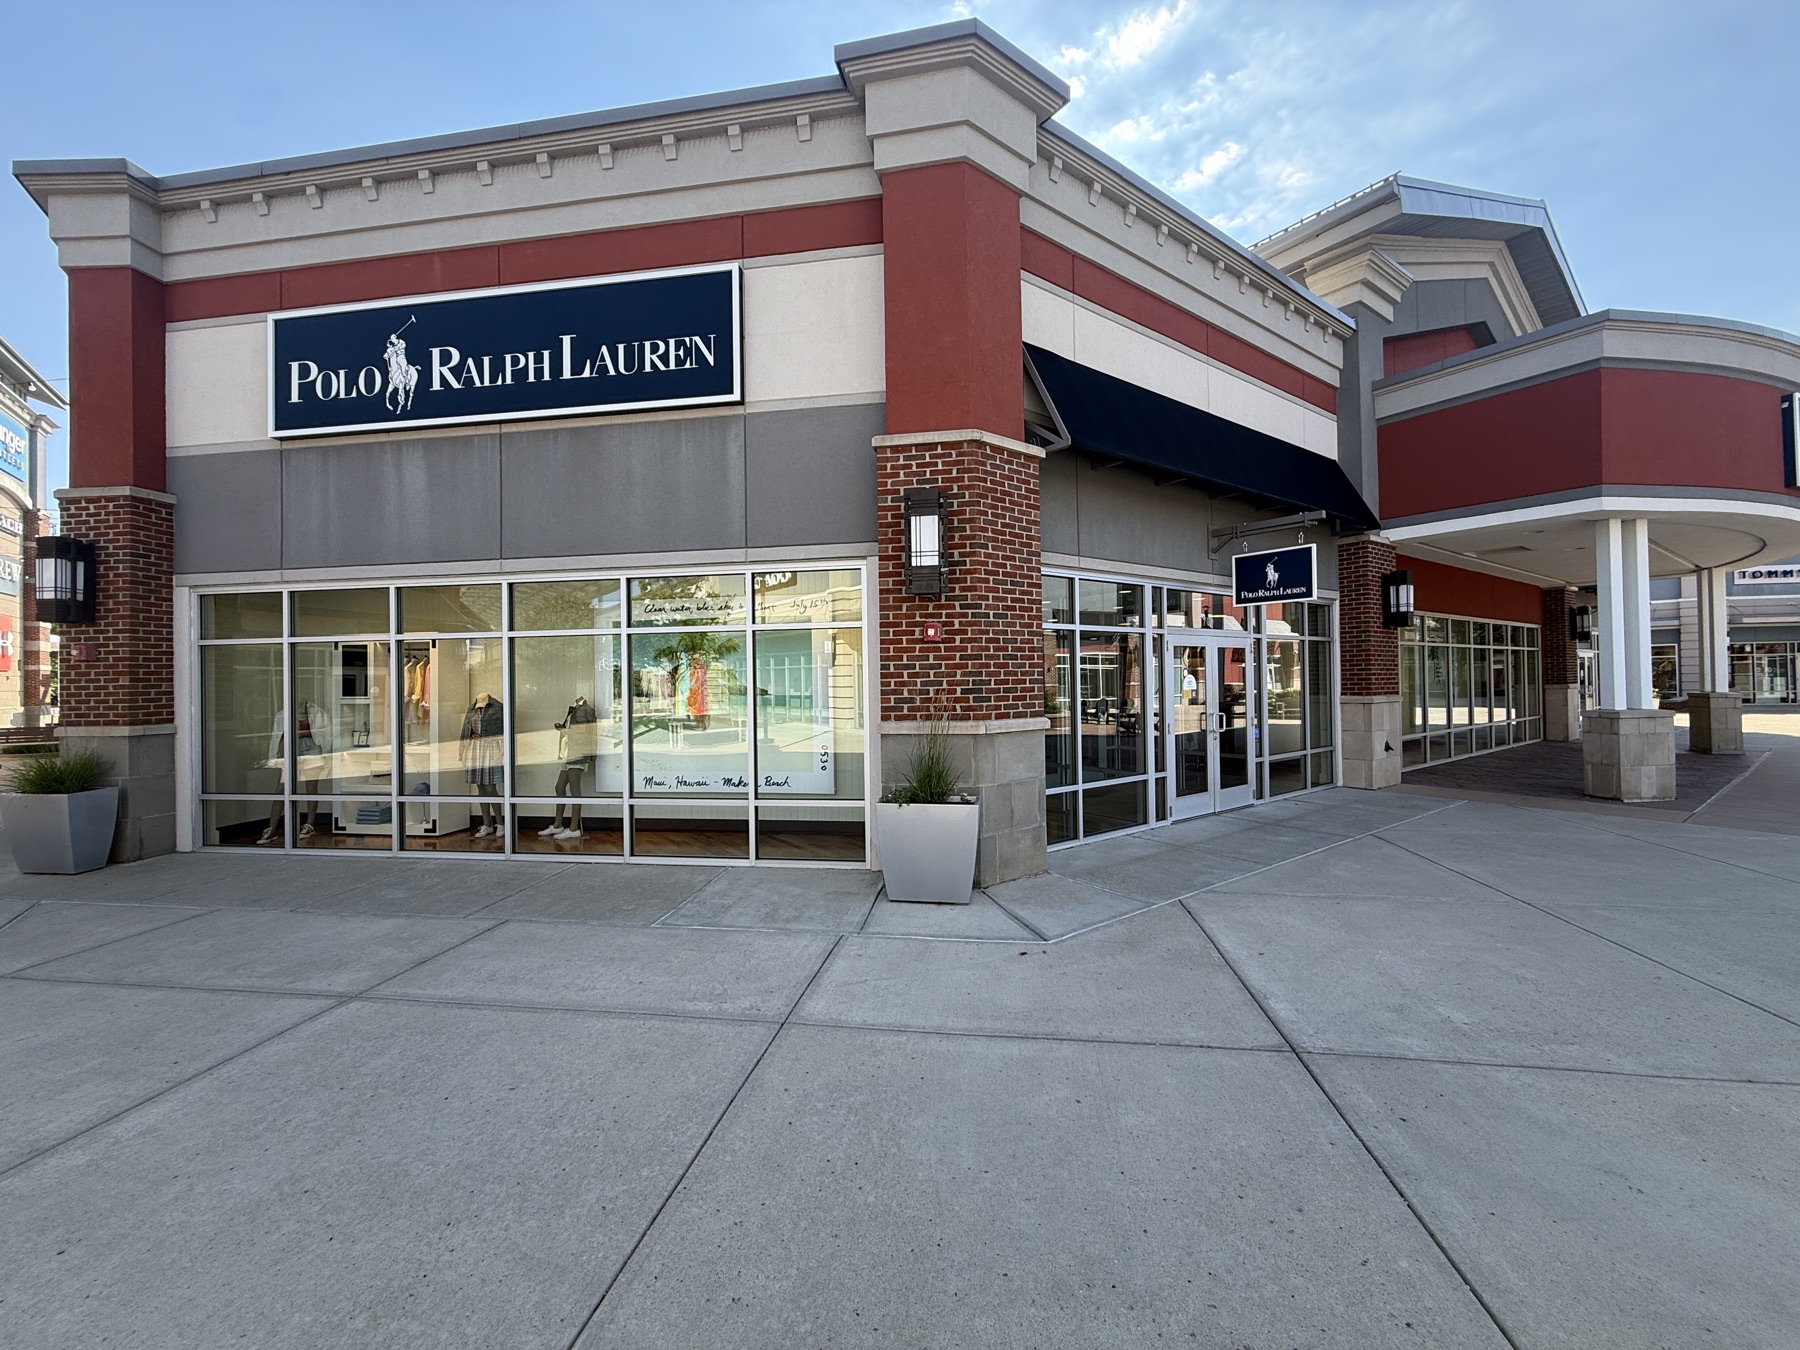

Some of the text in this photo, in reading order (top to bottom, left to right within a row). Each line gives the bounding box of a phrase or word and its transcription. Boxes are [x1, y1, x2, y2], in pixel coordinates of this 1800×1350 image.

[288, 333, 717, 403] POLO RALPH LAUREN
[1738, 569, 1800, 580] TOMM
[1241, 586, 1306, 599] POLO RALPH LAUREN
[789, 598, 807, 615] July
[674, 774, 710, 790] Hawaii
[764, 774, 793, 789] Beach
